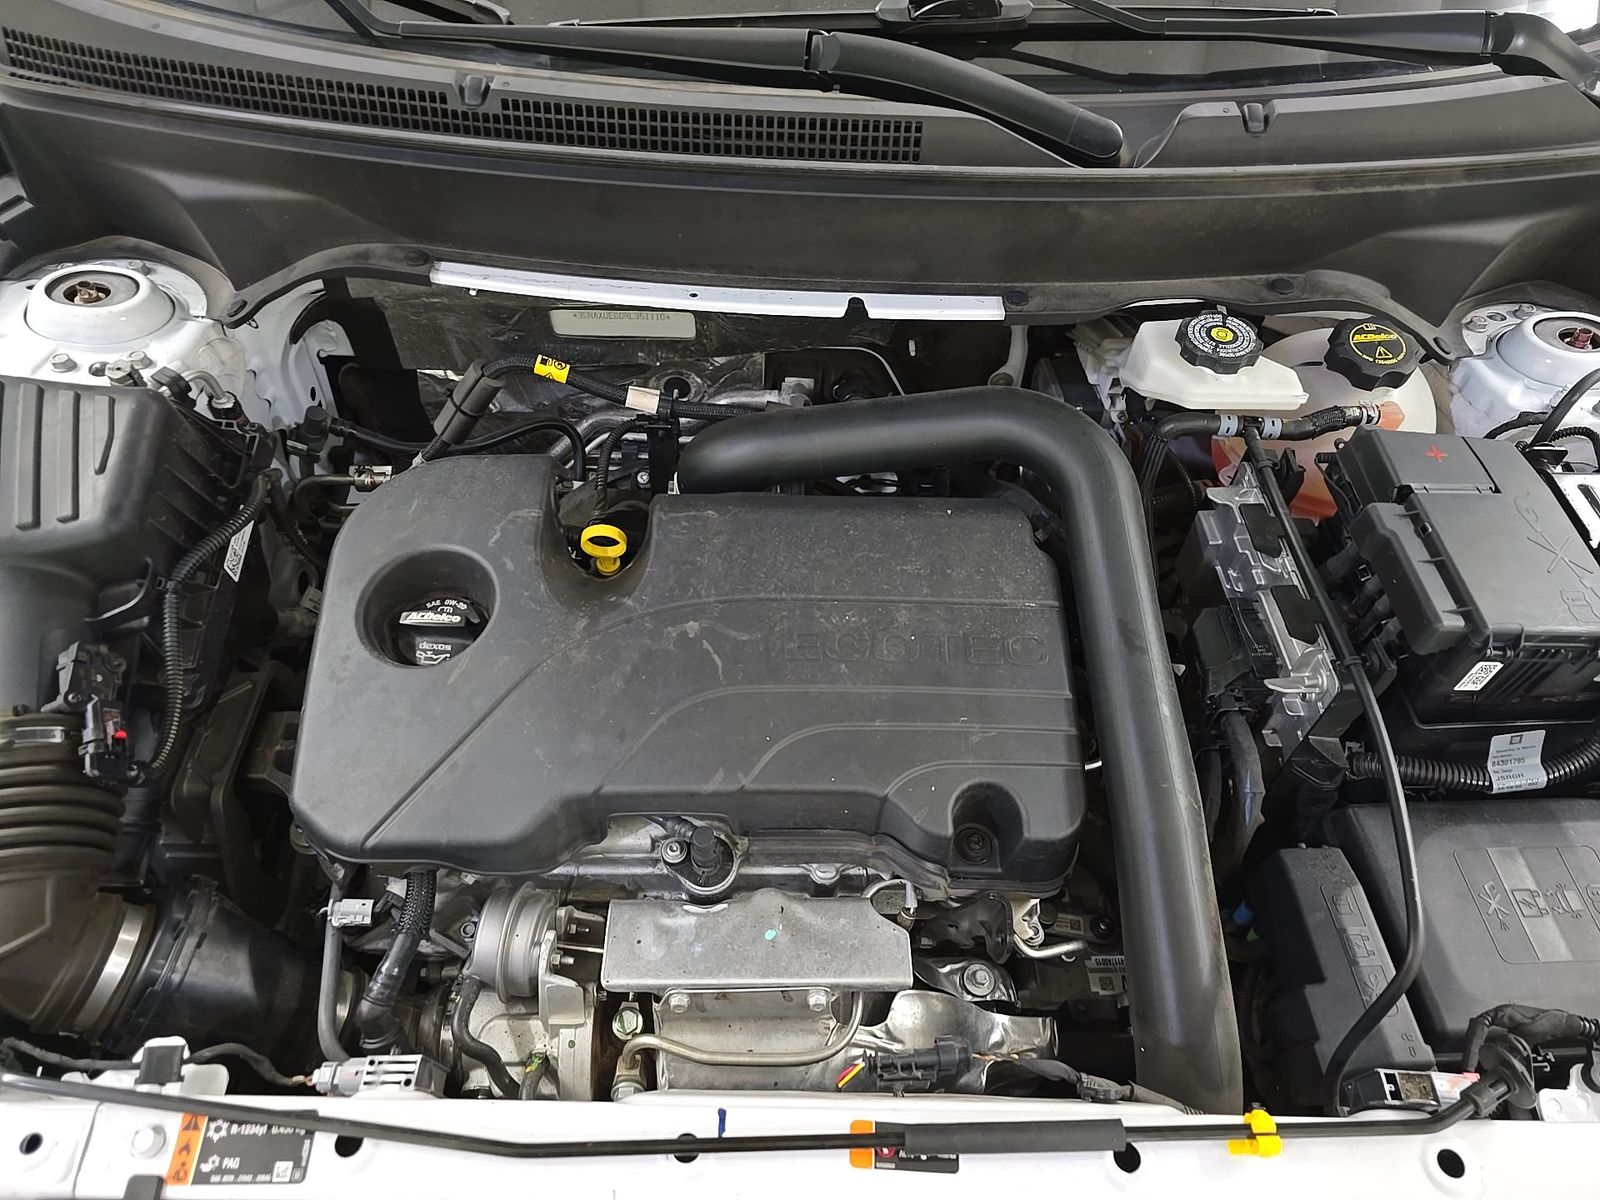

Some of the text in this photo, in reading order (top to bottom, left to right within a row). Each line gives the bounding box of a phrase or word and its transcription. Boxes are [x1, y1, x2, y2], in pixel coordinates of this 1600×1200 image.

[1353, 333, 1397, 342] ACDelco
[426, 600, 441, 609] SAE
[406, 611, 461, 622] ACDelco
[419, 641, 451, 651] dexos
[784, 631, 1049, 666] ECOTEC
[222, 1157, 240, 1170] PAG
